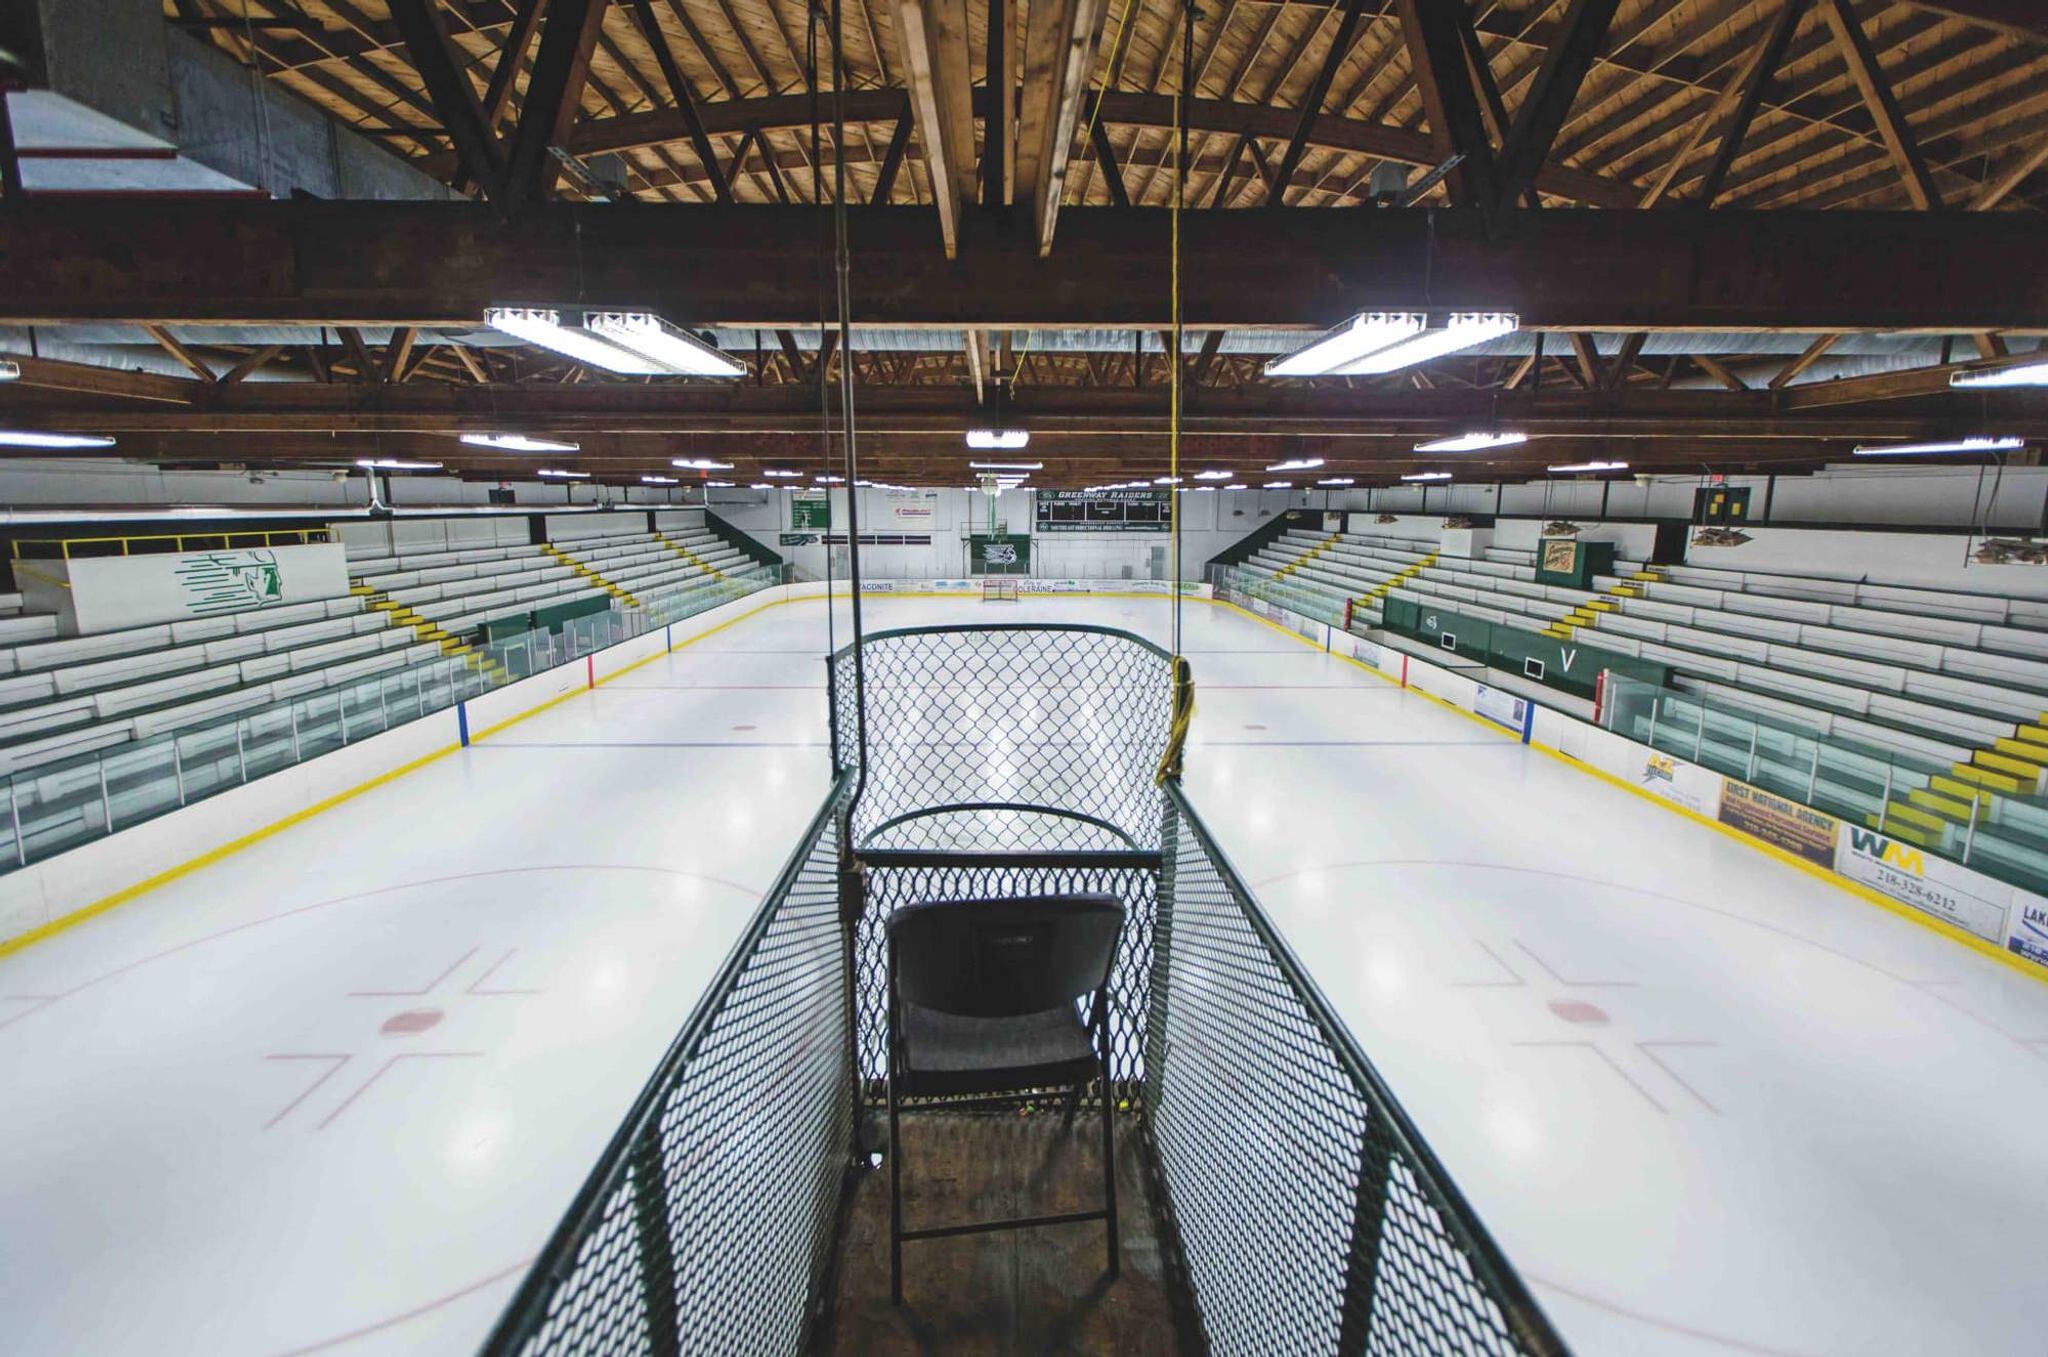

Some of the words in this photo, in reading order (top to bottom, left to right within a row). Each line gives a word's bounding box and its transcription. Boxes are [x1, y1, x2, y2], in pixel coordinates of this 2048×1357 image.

[1058, 491, 1107, 499] GREENWAY
[1111, 491, 1152, 499] RAIDERS
[1561, 647, 1576, 672] V
[1727, 781, 1750, 799] FIRST
[1752, 790, 1793, 817] NATIONAL
[1797, 808, 1834, 832] AGENCY
[1852, 827, 1925, 877] WM
[1876, 868, 1957, 912] 218-328-6212
[2023, 905, 2048, 928] LAK
